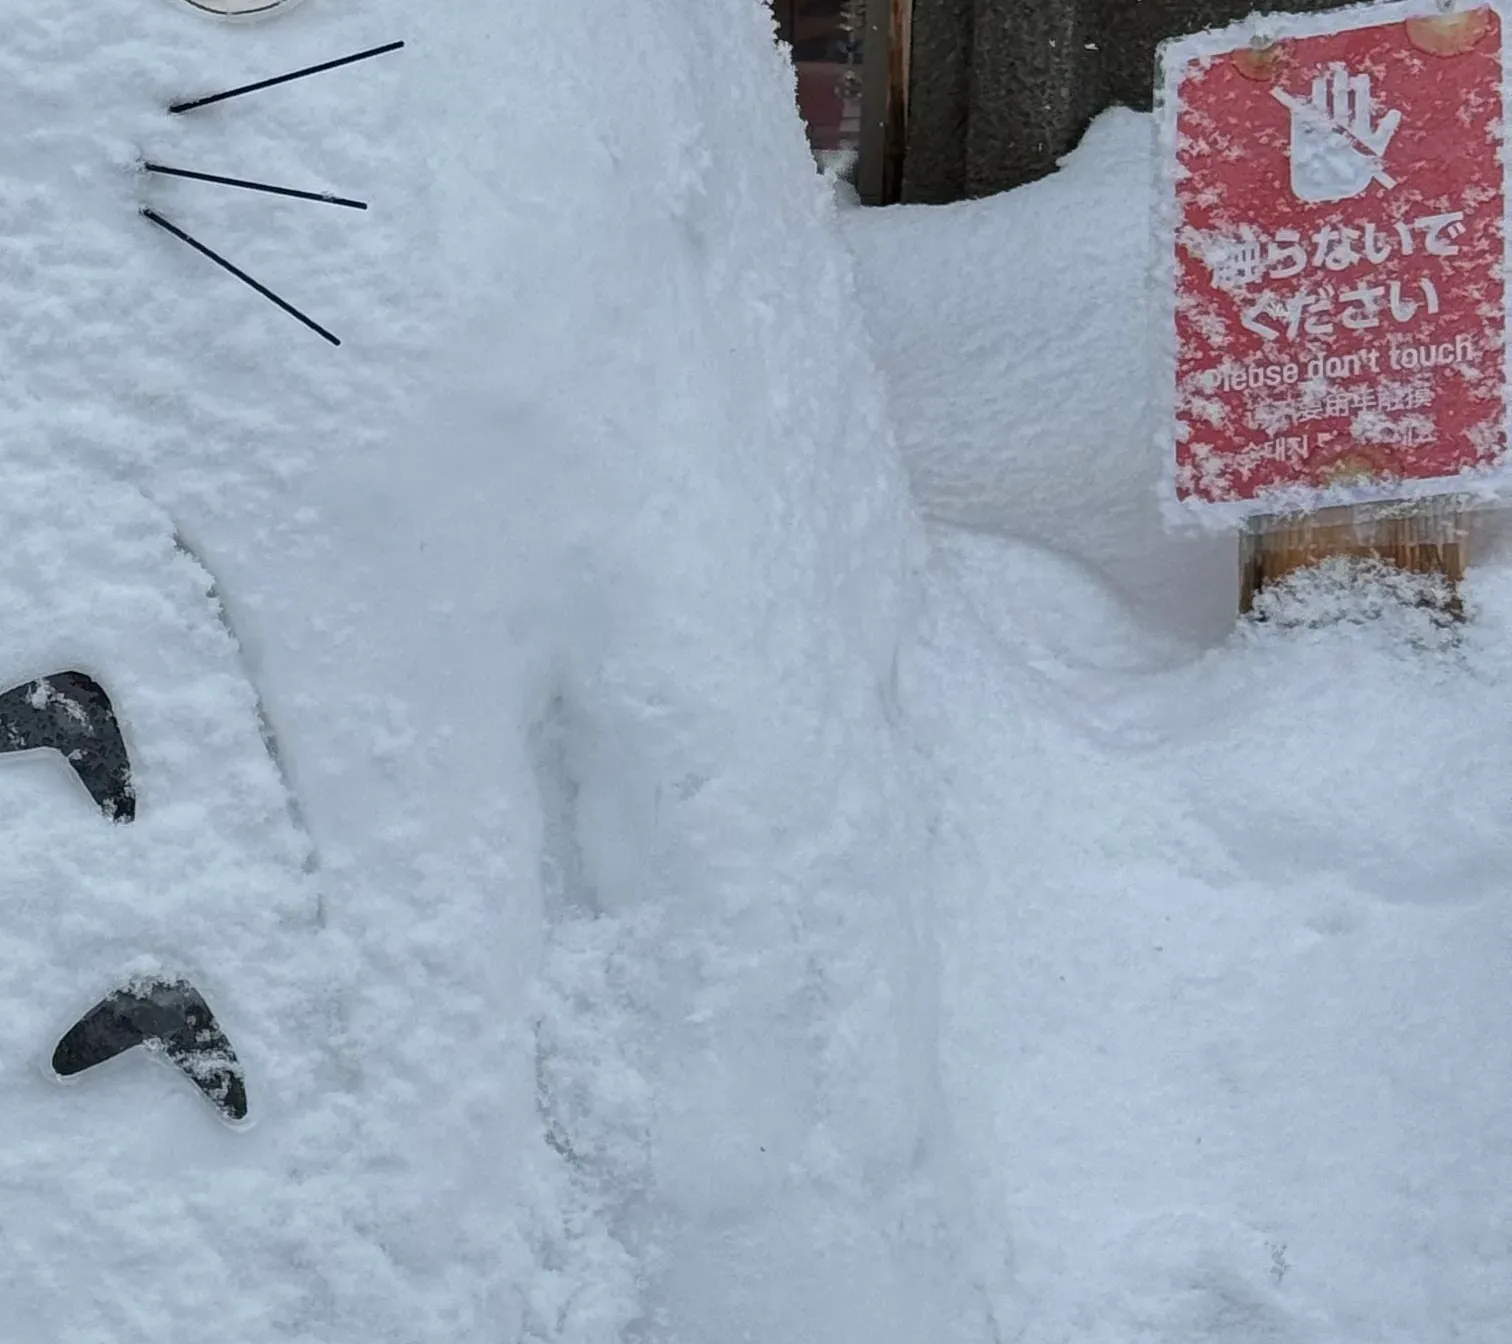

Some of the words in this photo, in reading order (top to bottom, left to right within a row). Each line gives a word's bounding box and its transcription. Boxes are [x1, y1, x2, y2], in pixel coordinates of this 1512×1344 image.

[1242, 279, 1438, 340] ください
[1388, 334, 1473, 370] touch
